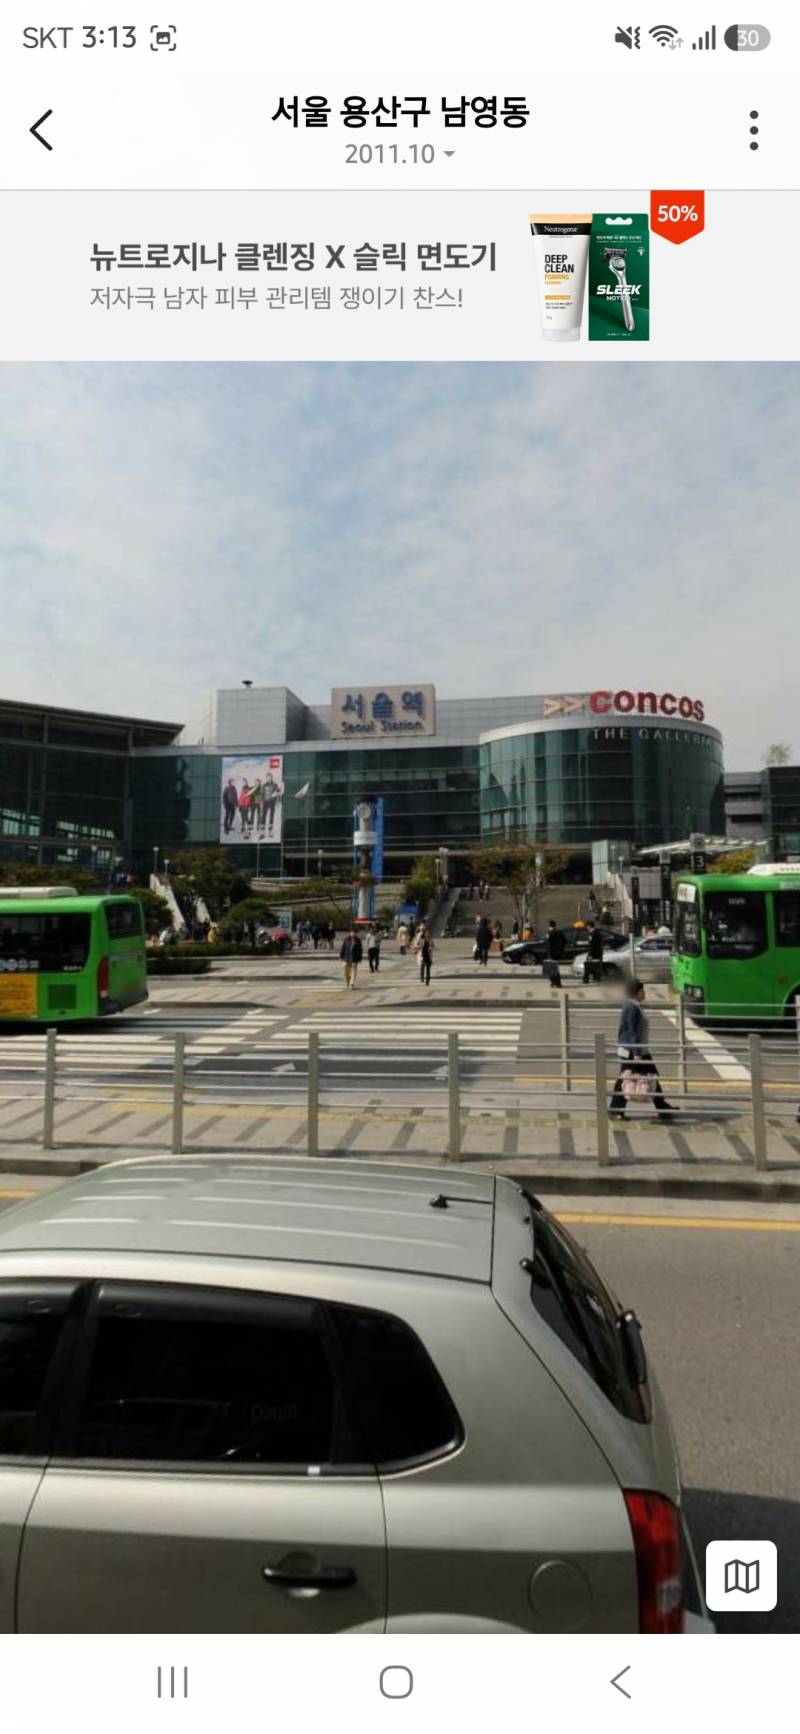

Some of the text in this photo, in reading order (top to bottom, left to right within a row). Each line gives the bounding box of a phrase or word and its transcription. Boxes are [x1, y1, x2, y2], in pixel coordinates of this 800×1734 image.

[544, 254, 568, 264] DEEP
[544, 264, 575, 273] CLEAN
[596, 284, 642, 295] SLEEK
[341, 690, 425, 719] 서울역
[341, 719, 424, 734] Seoul Station
[592, 727, 629, 740] THE
[696, 855, 705, 868] 3
